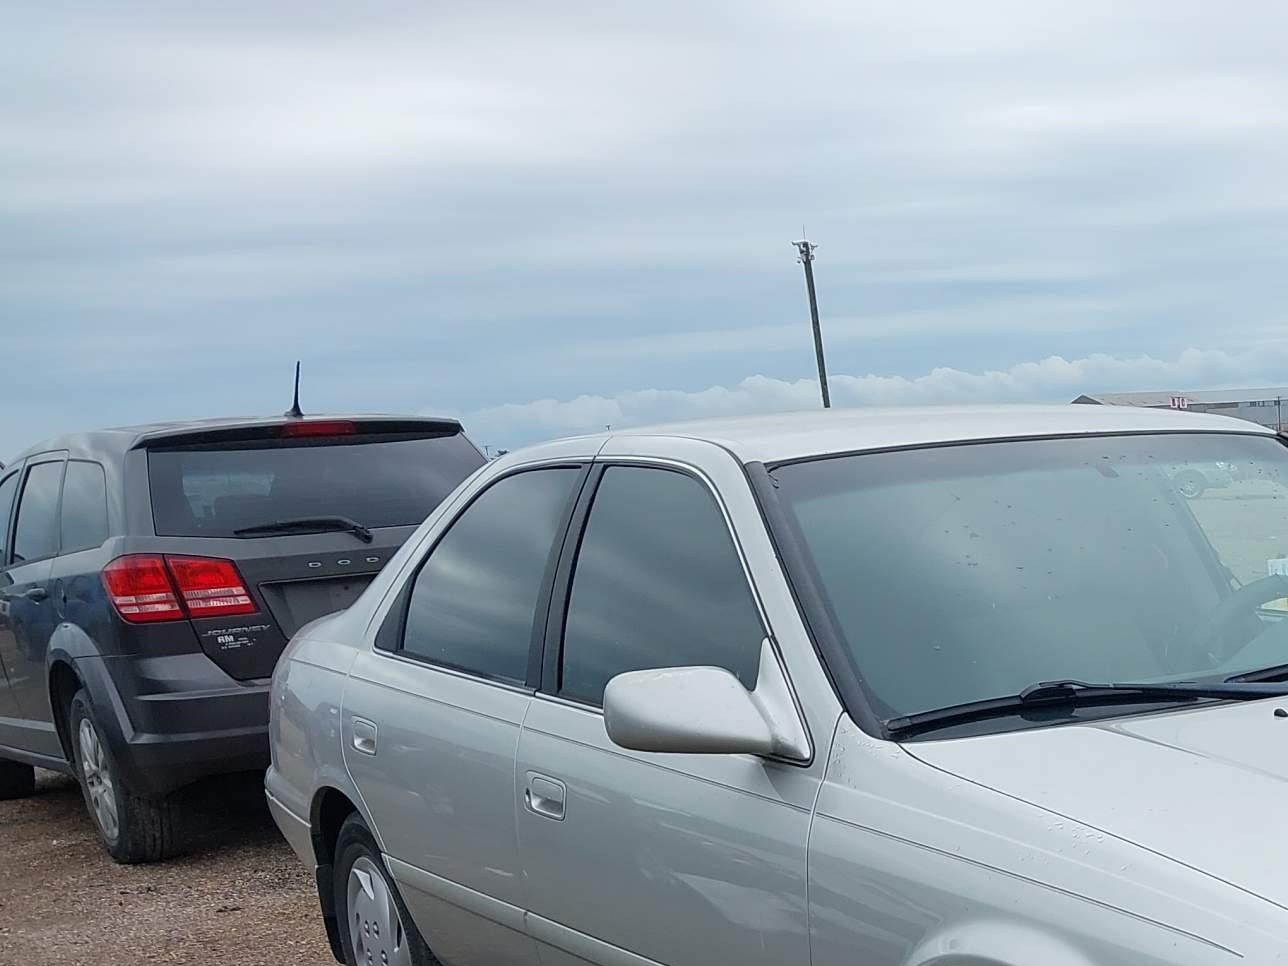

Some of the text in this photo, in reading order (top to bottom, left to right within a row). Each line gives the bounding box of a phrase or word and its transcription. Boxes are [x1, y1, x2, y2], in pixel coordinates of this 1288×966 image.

[308, 556, 380, 568] DOD
[201, 624, 271, 637] JOURNEY
[217, 634, 235, 644] RM
